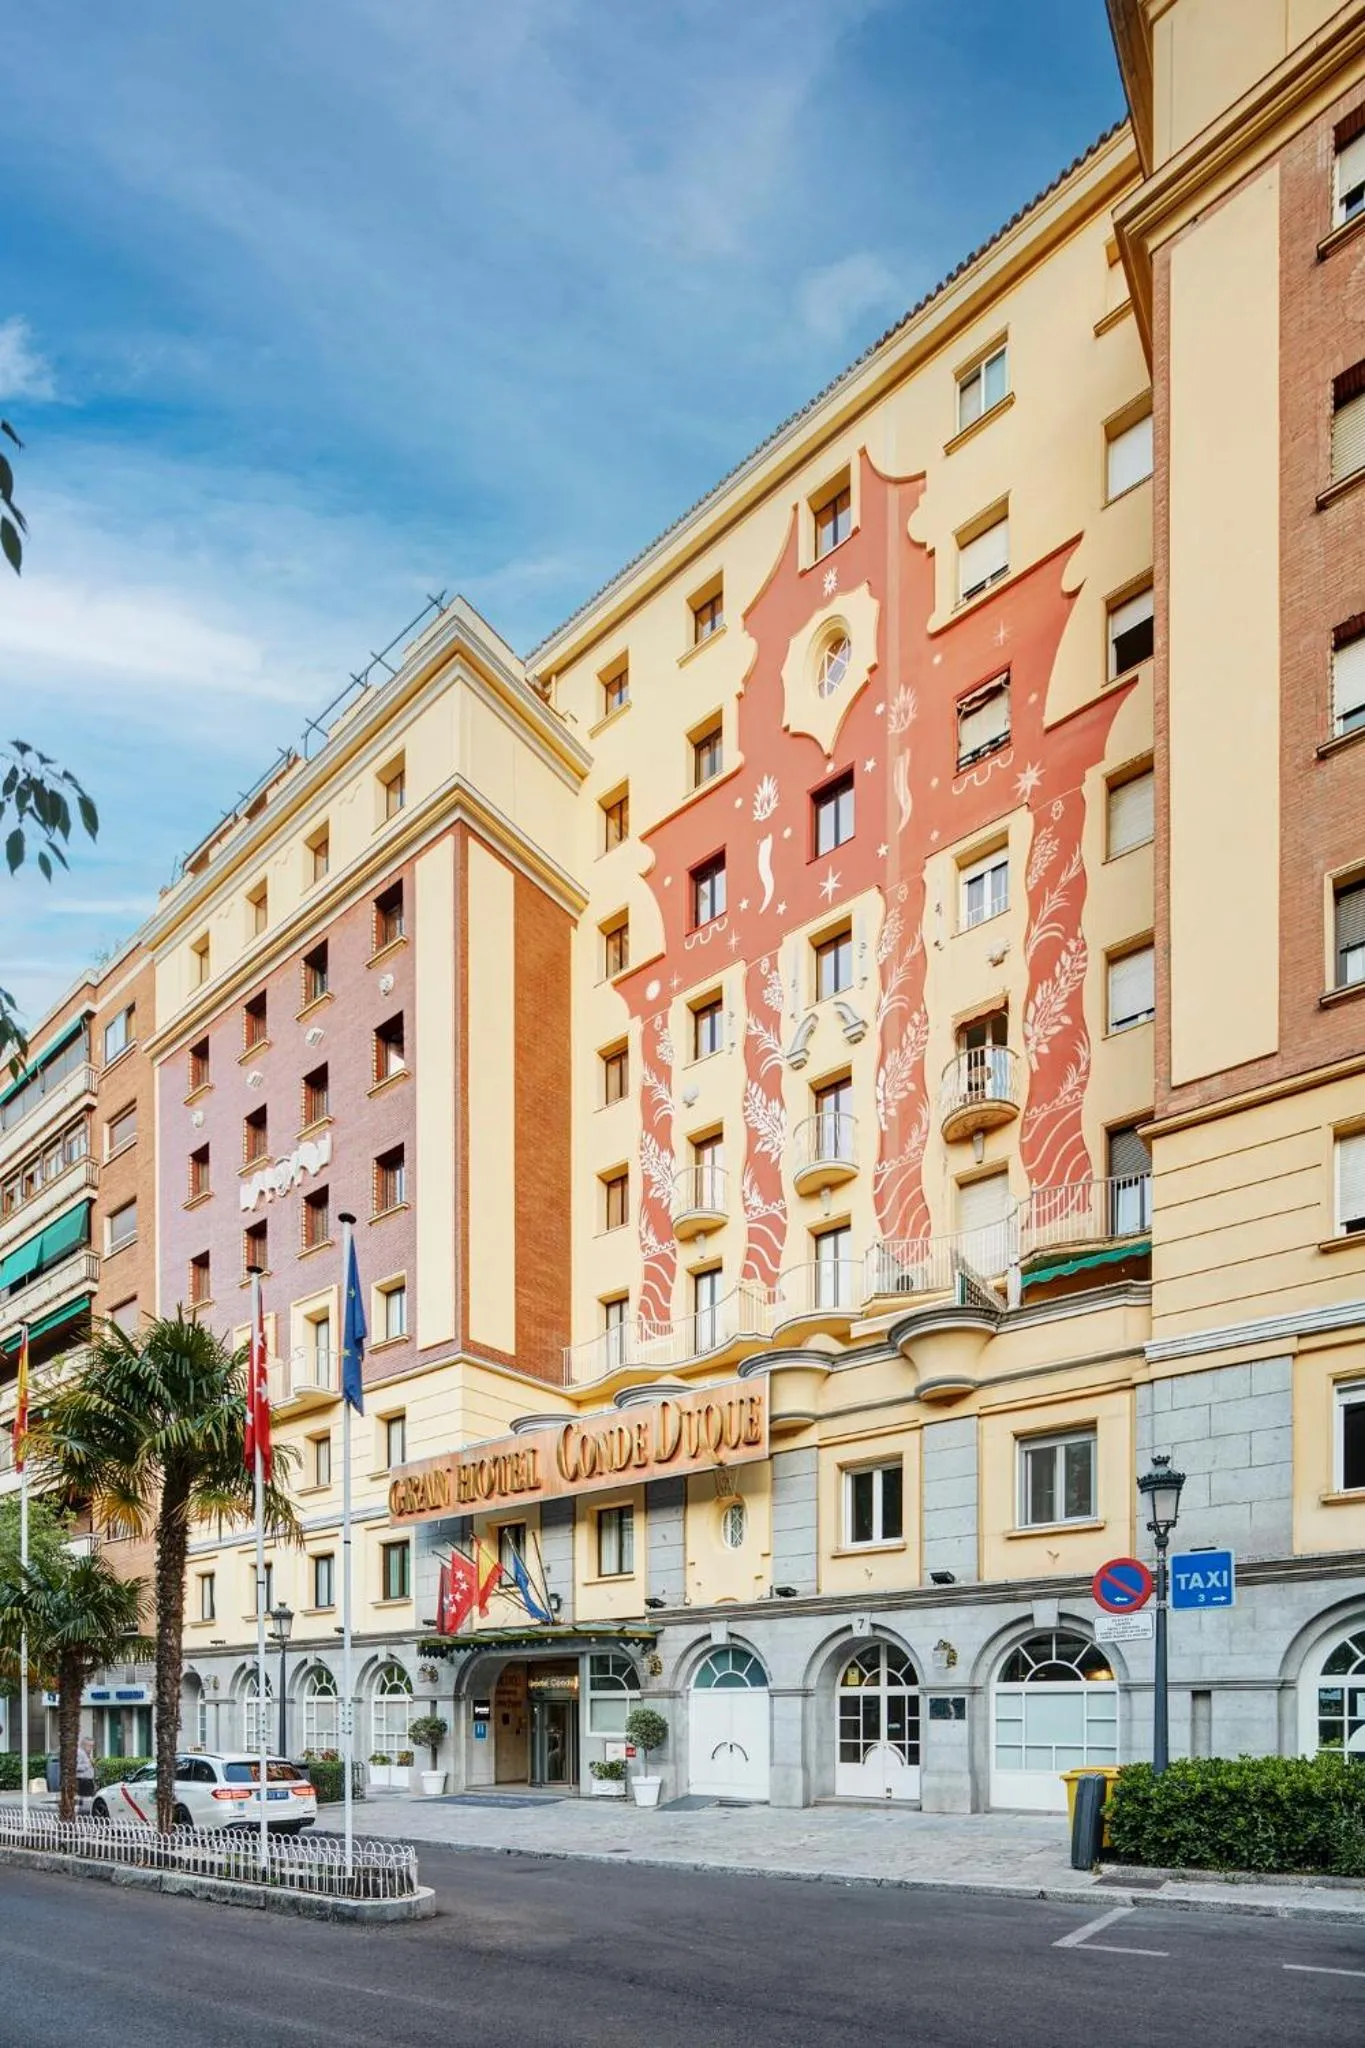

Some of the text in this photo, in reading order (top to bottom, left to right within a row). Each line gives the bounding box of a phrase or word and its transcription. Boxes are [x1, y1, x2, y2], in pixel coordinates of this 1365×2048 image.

[389, 1396, 763, 1517] GRAN HOTEL CONDE DUQUE
[1176, 1570, 1229, 1591] TAXI
[857, 1618, 865, 1630] 7
